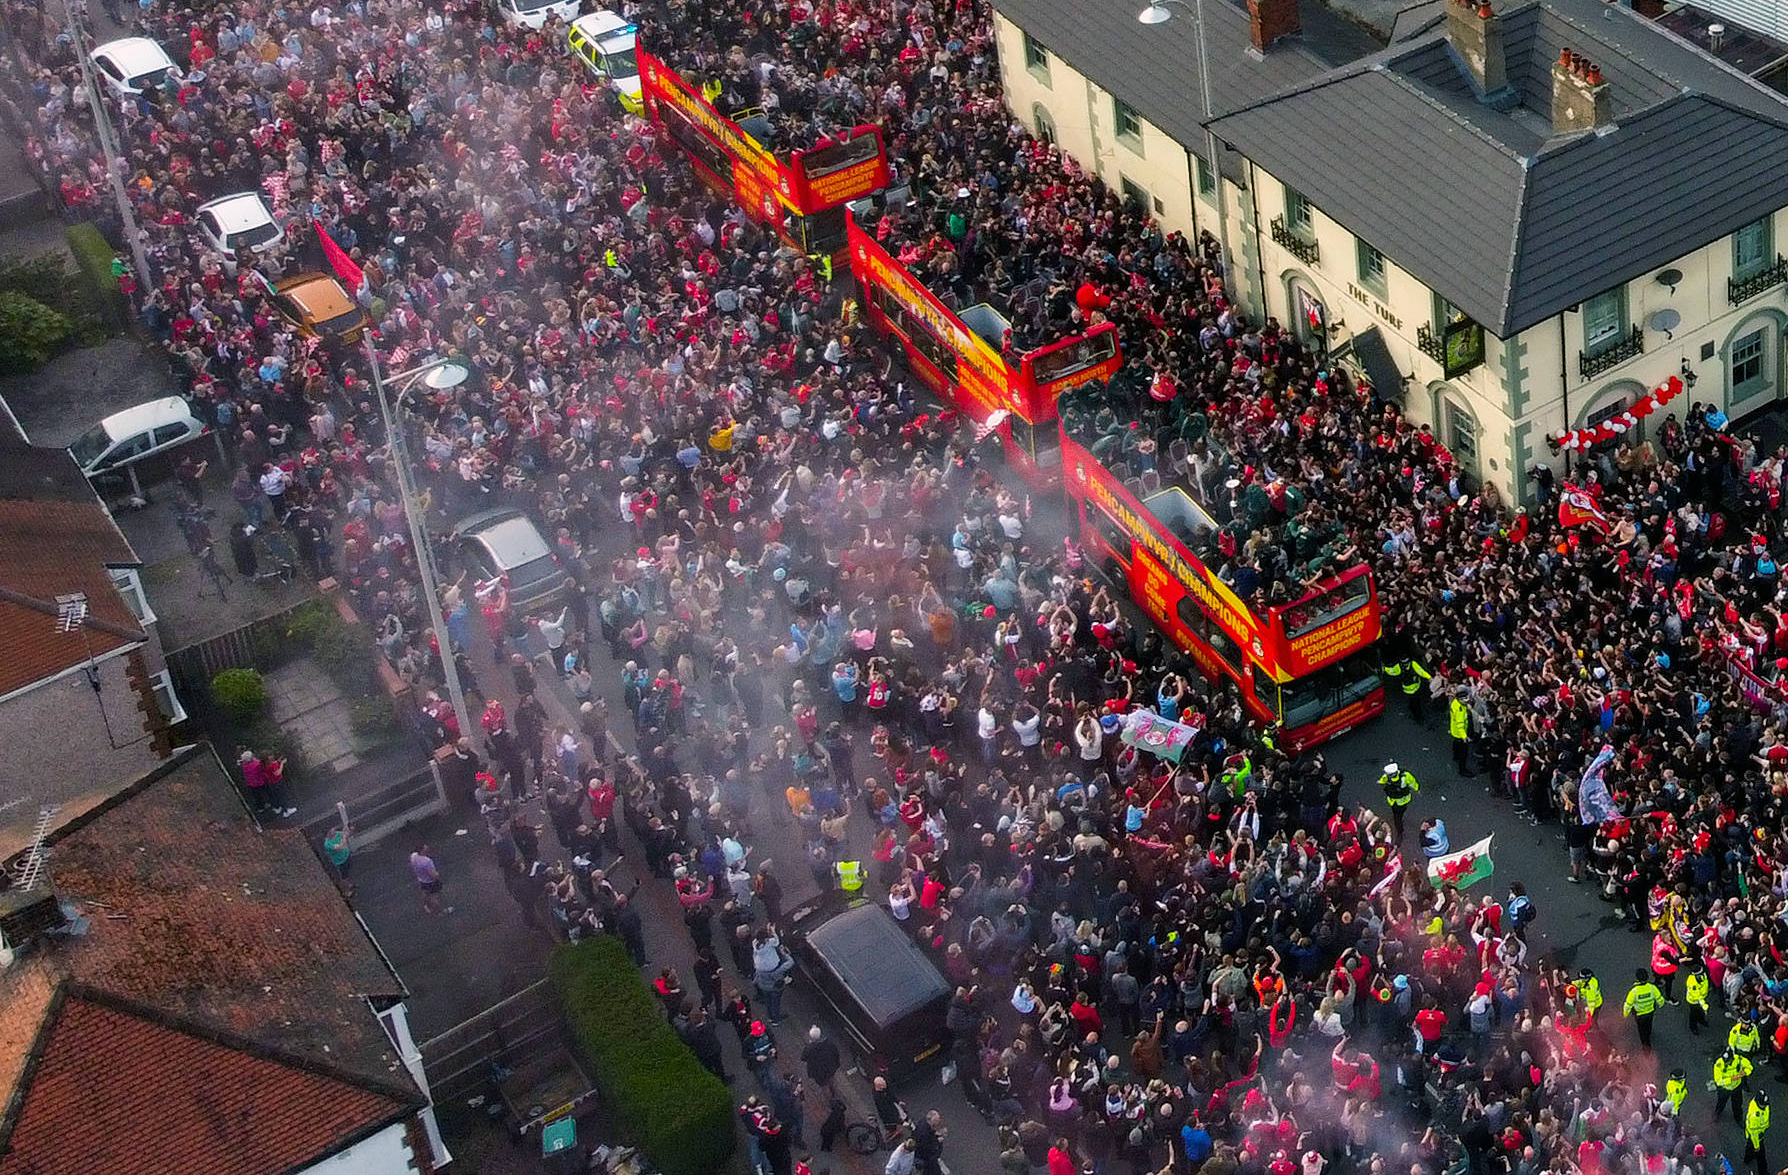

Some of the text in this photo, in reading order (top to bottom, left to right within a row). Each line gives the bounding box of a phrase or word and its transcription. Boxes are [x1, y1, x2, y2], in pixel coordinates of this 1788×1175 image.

[1347, 282, 1403, 331] THE TURF
[1090, 475, 1169, 563] PENCAMPWYR
[1178, 562, 1249, 643] CHAMPIONS
[1291, 607, 1370, 651] NATIONAL LEAGUE
[1308, 633, 1361, 665] CHAMPIONS
[874, 691, 883, 701] 10
